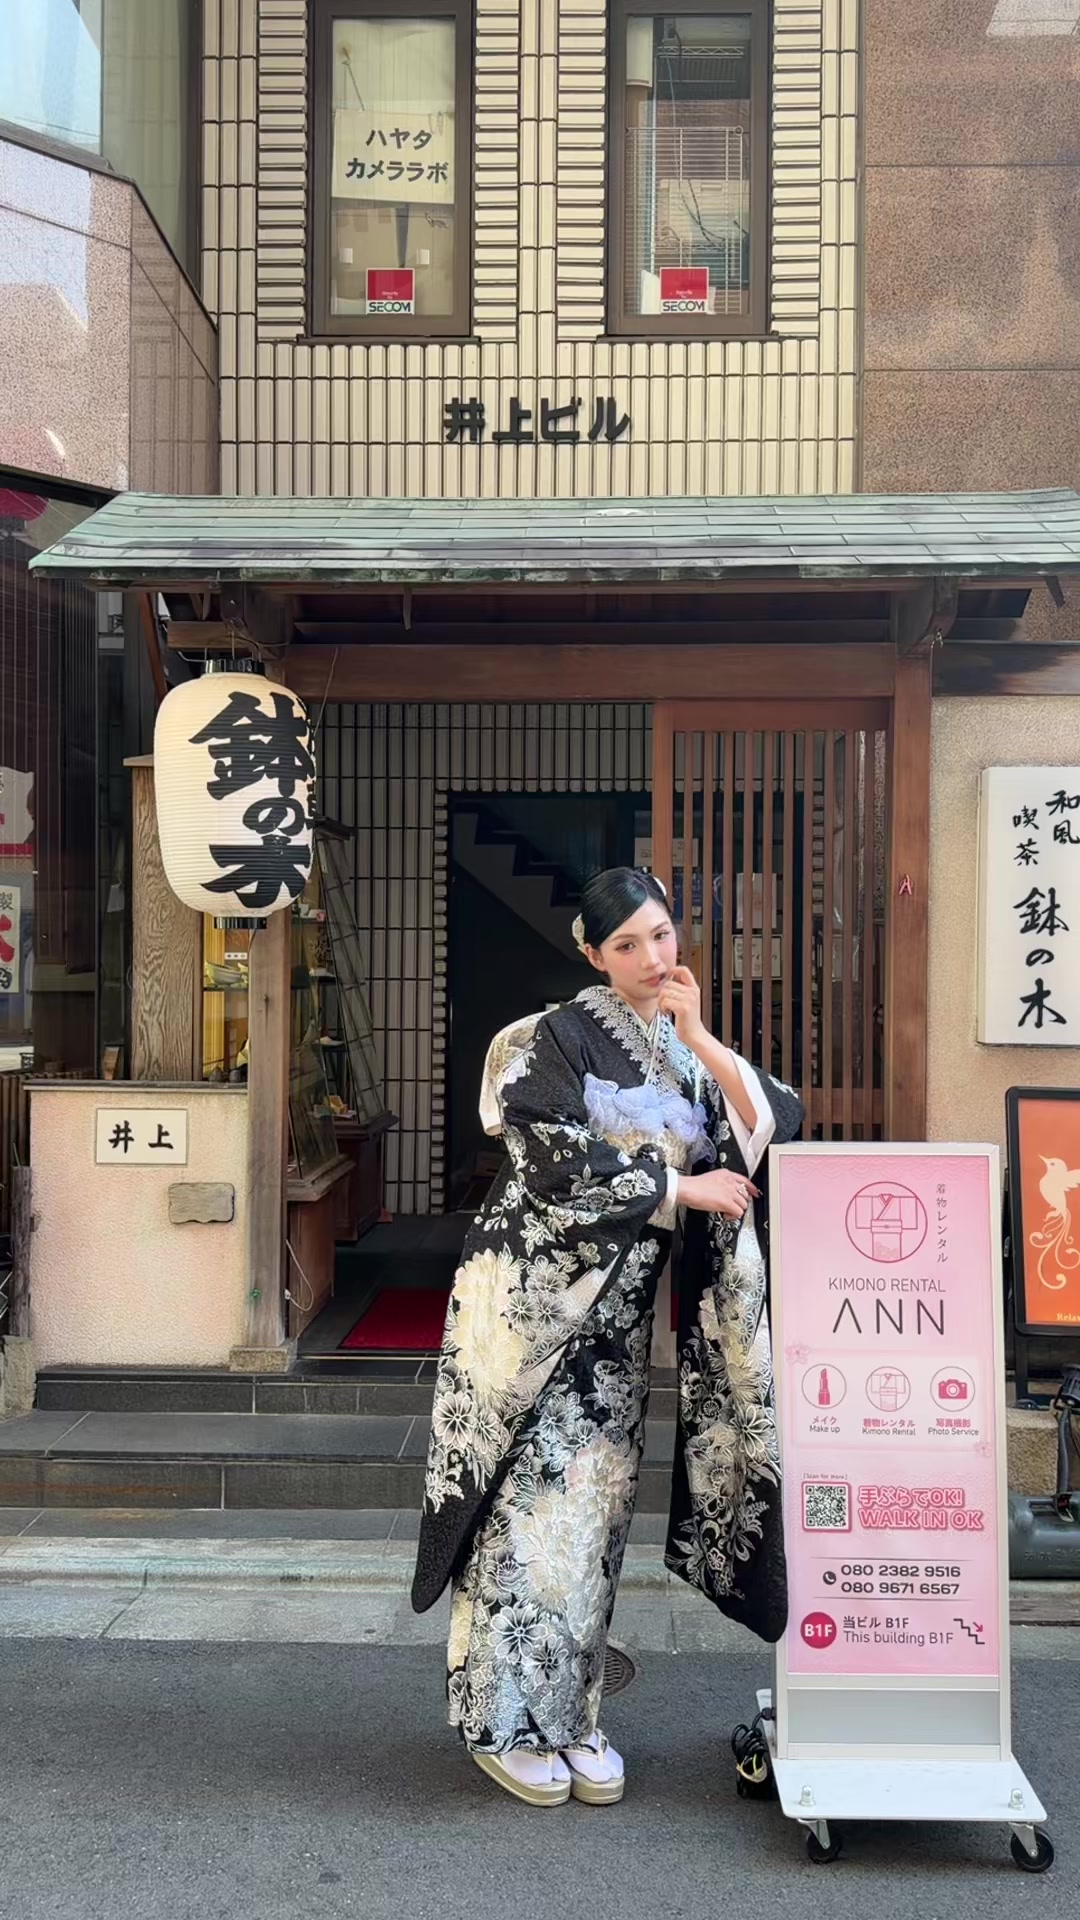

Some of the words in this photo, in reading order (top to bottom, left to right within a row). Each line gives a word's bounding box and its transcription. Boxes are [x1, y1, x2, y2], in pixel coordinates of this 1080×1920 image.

[366, 128, 432, 150] ハヤタ
[345, 158, 449, 183] カメララボ
[369, 301, 411, 312] SECOM
[663, 300, 705, 311] SECOM
[443, 396, 631, 441] 井上ビル
[188, 691, 316, 908] 鉢の木
[1046, 790, 1080, 845] 和風
[1012, 805, 1040, 867] 喫茶
[1013, 887, 1070, 1029] 鉢の木
[108, 1120, 174, 1154] 井上
[936, 1183, 948, 1263] 着物レンタル
[828, 1277, 886, 1292] KIMONO
[890, 1278, 946, 1292] RENTAL
[812, 1416, 838, 1425] メイク
[863, 1418, 916, 1428] 着物レンタル
[809, 1425, 829, 1433] Make
[892, 1428, 916, 1436] Rental
[928, 1427, 950, 1435] Photo
[951, 1428, 979, 1436] Service
[858, 1486, 965, 1508] 手ぶらでOK!
[858, 1508, 918, 1529] WALK
[921, 1510, 947, 1529] IN
[951, 1511, 984, 1530] OK
[841, 1564, 874, 1576] 080
[878, 1565, 919, 1577] 2382
[924, 1566, 961, 1577] 9516
[841, 1582, 874, 1593] 080
[879, 1583, 914, 1594] 9671
[919, 1583, 960, 1595] 6567
[843, 1615, 881, 1629] 当ビル
[885, 1617, 909, 1629] B1F
[804, 1624, 833, 1637] B1F
[843, 1631, 870, 1643] This
[874, 1631, 925, 1647] building
[929, 1633, 954, 1644] B1F
